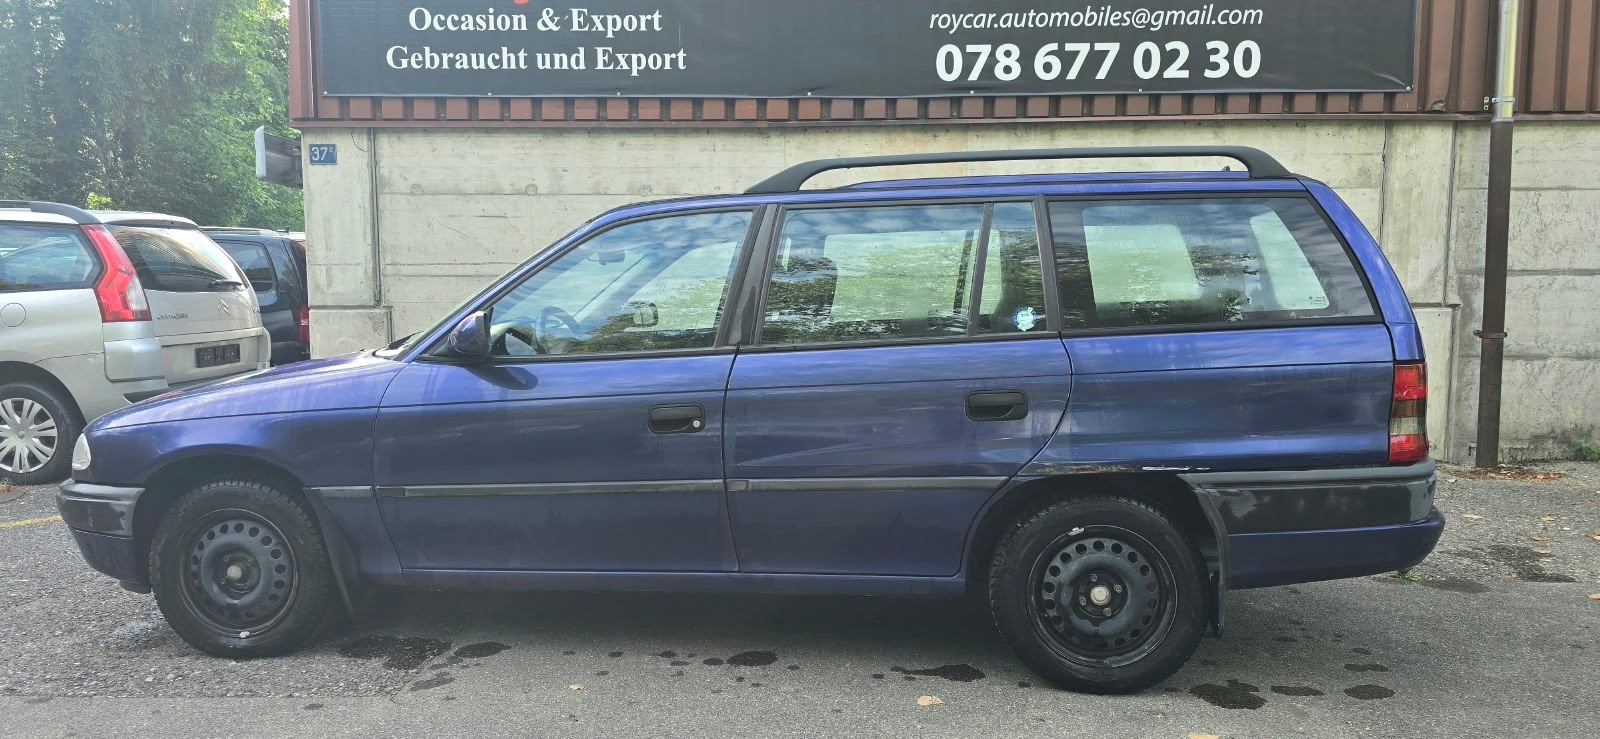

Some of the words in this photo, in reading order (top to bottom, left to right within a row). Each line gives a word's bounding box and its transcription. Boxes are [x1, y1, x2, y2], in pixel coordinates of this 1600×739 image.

[408, 7, 529, 32] Occasion
[536, 7, 562, 32] &
[569, 7, 663, 39] Export
[929, 4, 1264, 35] roycar.automobiles@gmail.com
[385, 46, 529, 70] Gebraucht
[535, 46, 587, 70] und
[593, 46, 687, 77] Export
[935, 43, 1022, 82] 078
[1033, 42, 1121, 81] 677
[1133, 41, 1190, 80] 02
[1203, 39, 1262, 79] 30
